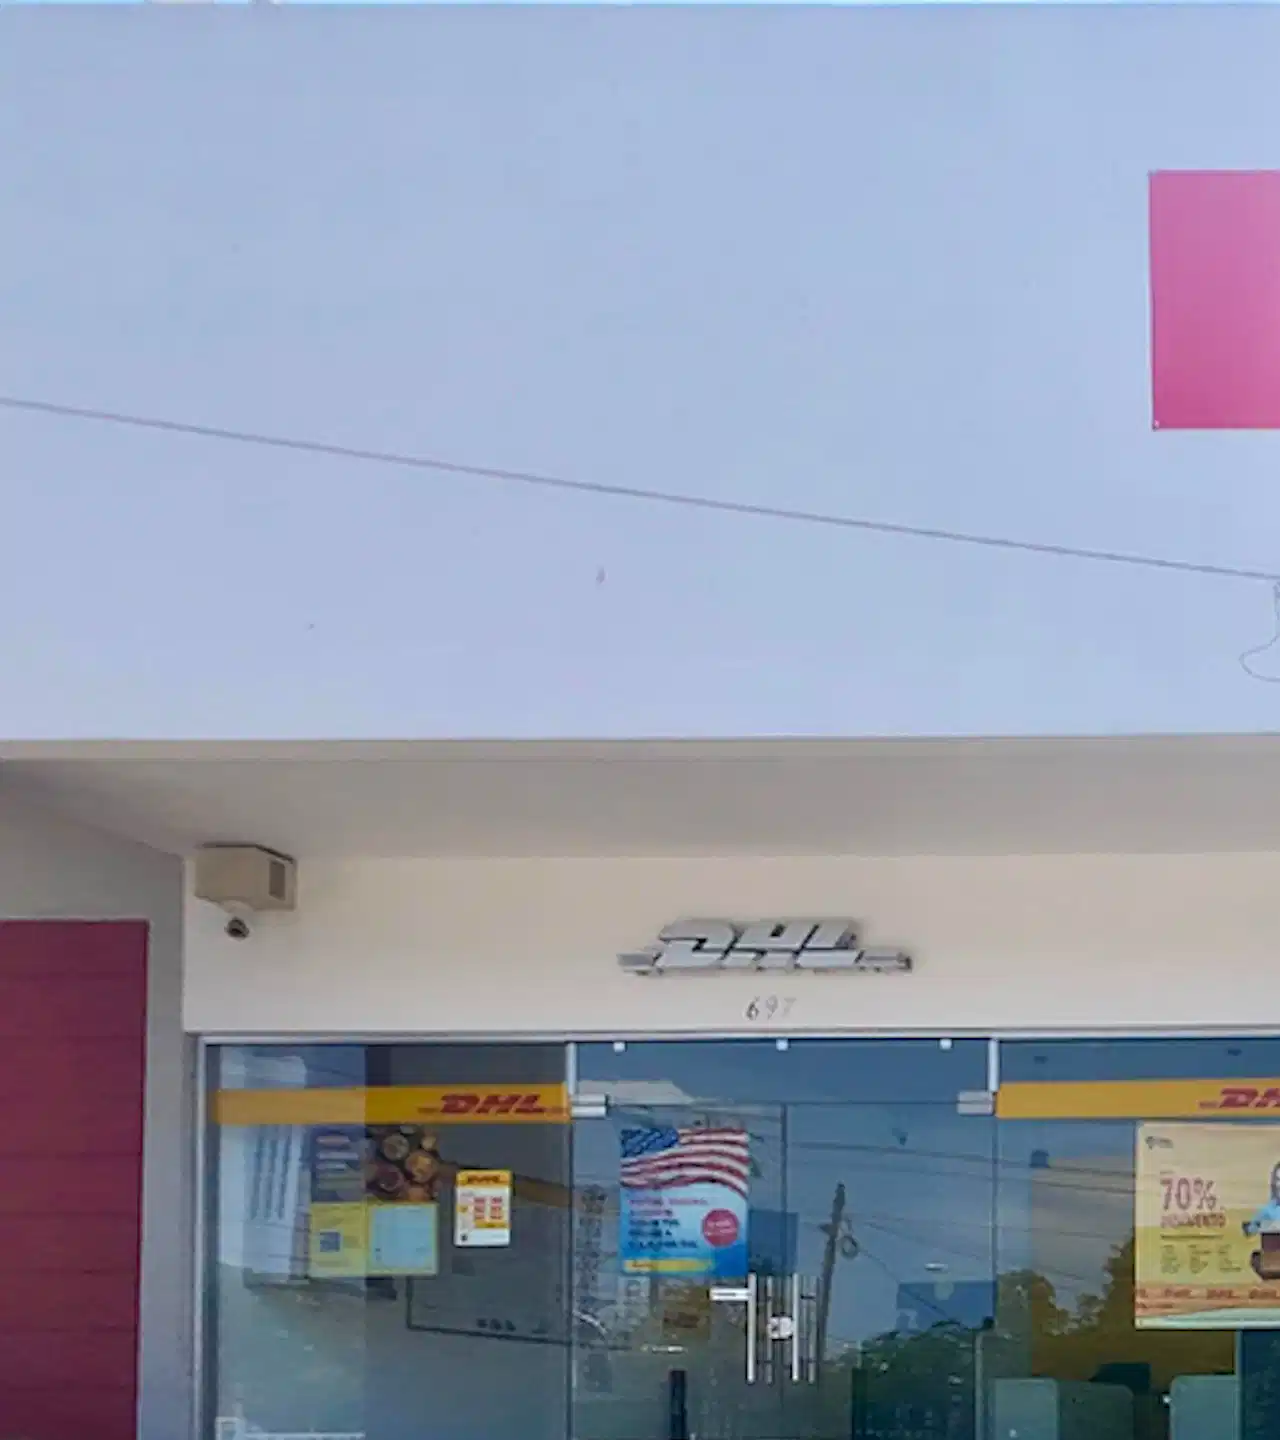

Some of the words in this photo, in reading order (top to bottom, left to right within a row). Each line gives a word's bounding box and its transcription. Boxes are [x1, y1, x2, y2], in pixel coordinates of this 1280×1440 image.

[653, 919, 860, 972] DHL
[440, 1093, 546, 1114] DHL
[1160, 1176, 1218, 1212] 70%
